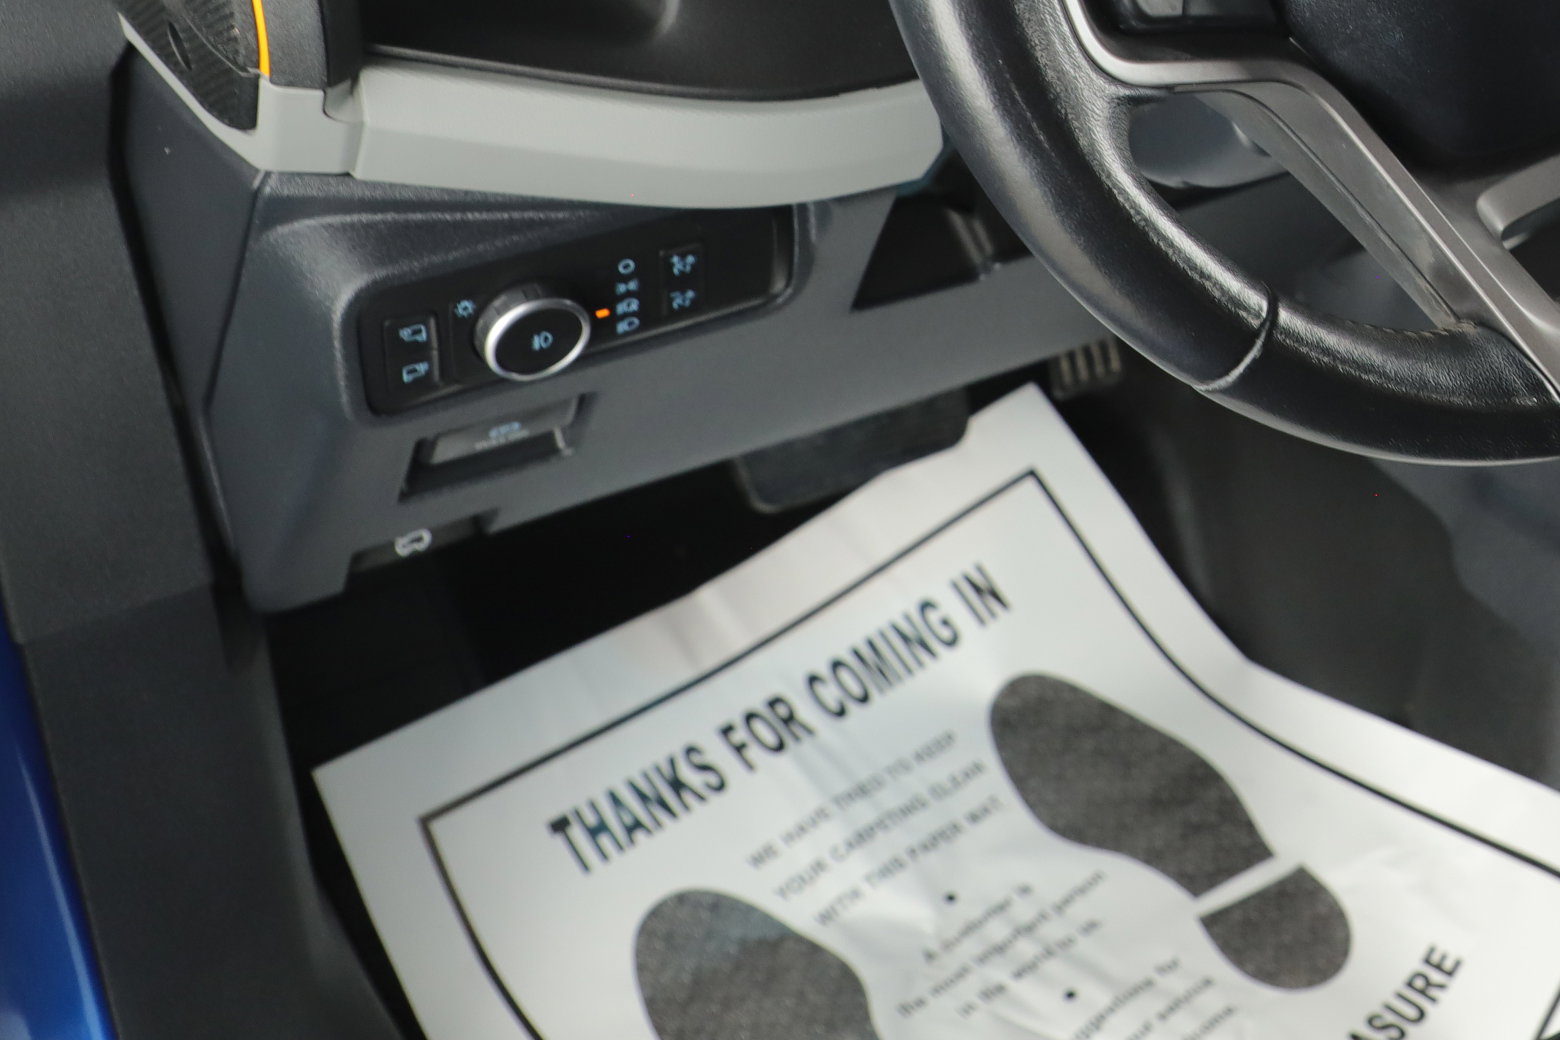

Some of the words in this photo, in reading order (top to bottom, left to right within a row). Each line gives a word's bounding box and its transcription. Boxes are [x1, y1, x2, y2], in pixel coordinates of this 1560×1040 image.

[547, 744, 728, 875] THANKS
[717, 694, 816, 773] FOR
[806, 598, 960, 718] COMING
[950, 563, 1012, 627] IN
[775, 858, 830, 900] YOUR
